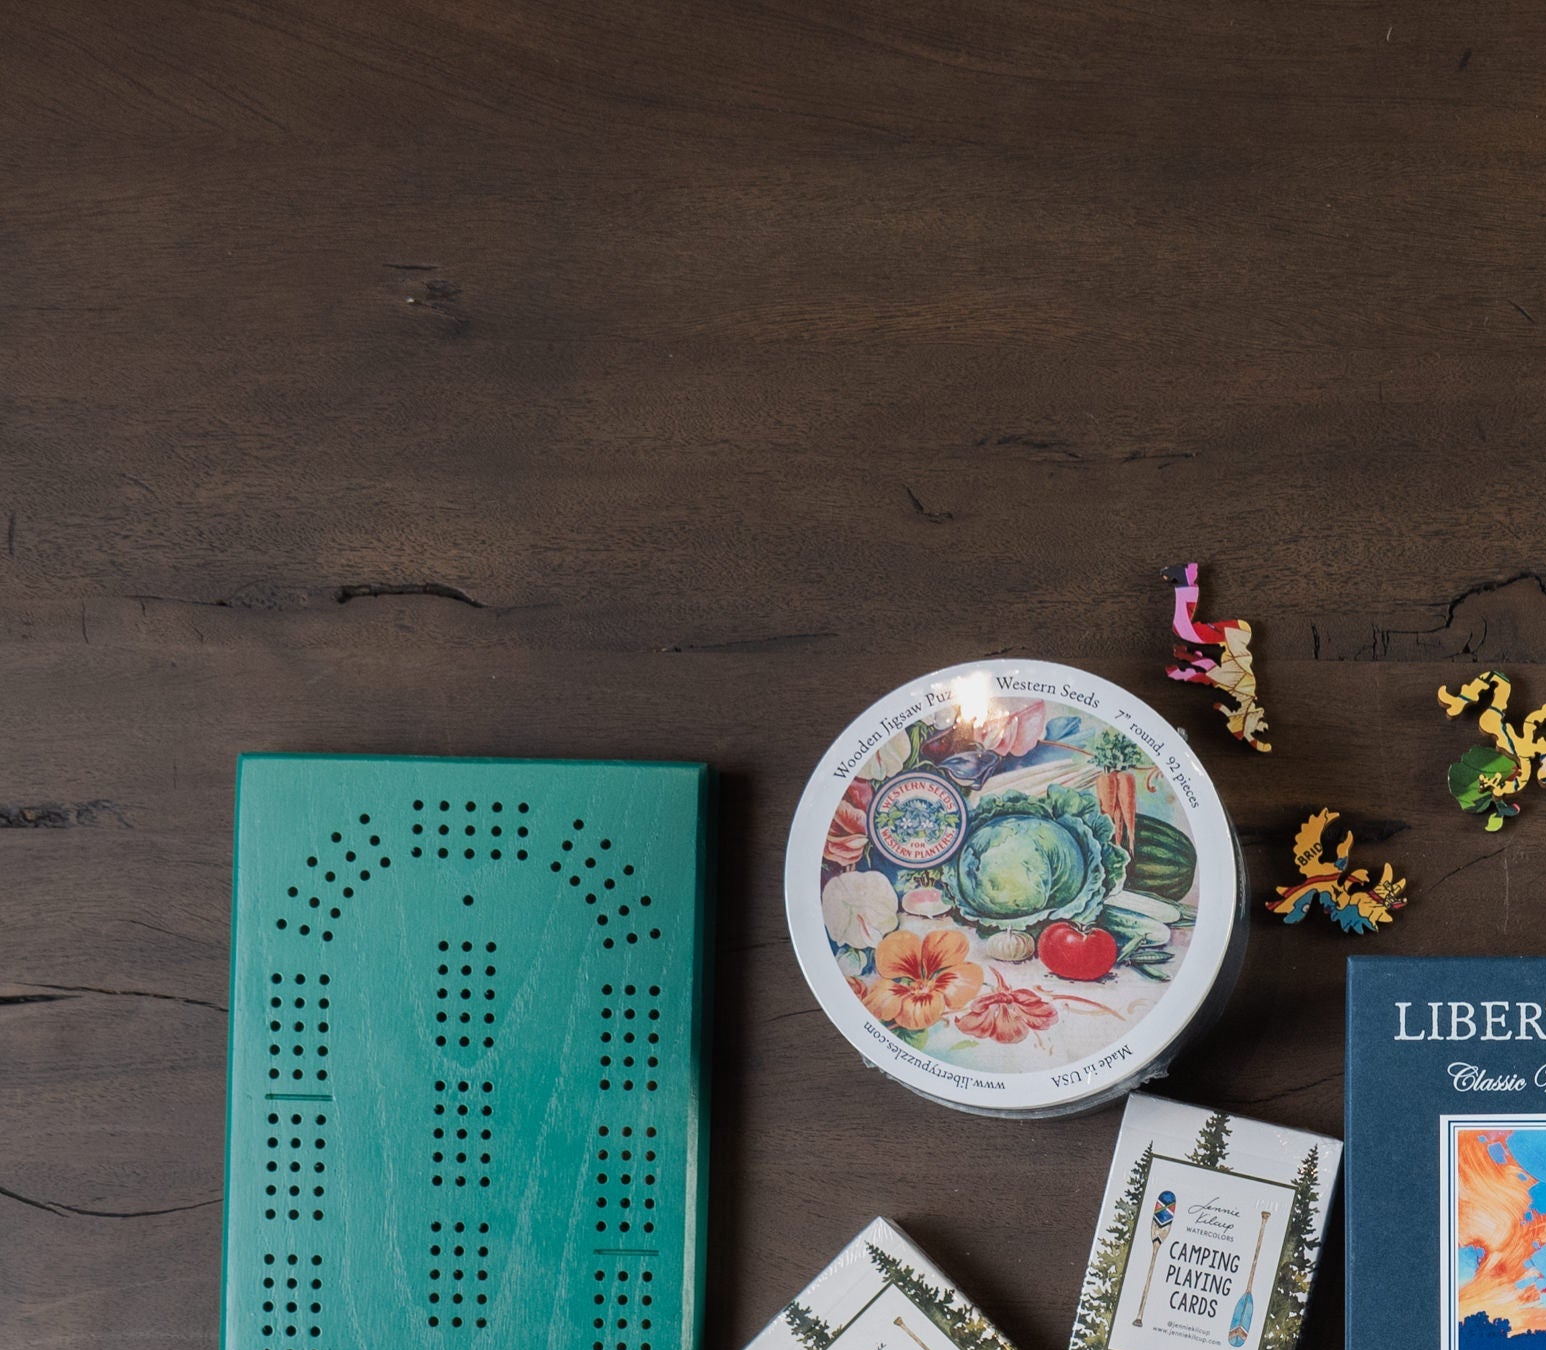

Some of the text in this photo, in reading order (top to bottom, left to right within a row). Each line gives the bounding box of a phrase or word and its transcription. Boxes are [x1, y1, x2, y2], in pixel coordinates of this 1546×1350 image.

[996, 676, 1056, 695] Western
[1060, 684, 1101, 709] Seeds
[880, 702, 923, 736] Jigsaw
[1129, 721, 1166, 757] round,
[833, 732, 883, 779] Wooden
[1165, 756, 1181, 774] 92
[882, 782, 955, 811] WESTERN SEEDS
[1172, 773, 1200, 809] pieces
[881, 828, 912, 857] WESTERN
[863, 1021, 1006, 1090] www.libertypuzzles.com
[1099, 1044, 1135, 1068] Made
[1051, 1069, 1083, 1088] USA
[1447, 1061, 1527, 1093] Classic
[1186, 1226, 1235, 1243] WATERCOLORS
[1169, 1241, 1241, 1274] CAMPING
[1165, 1264, 1233, 1297] PLAYING
[1169, 1290, 1218, 1318] CARDS
